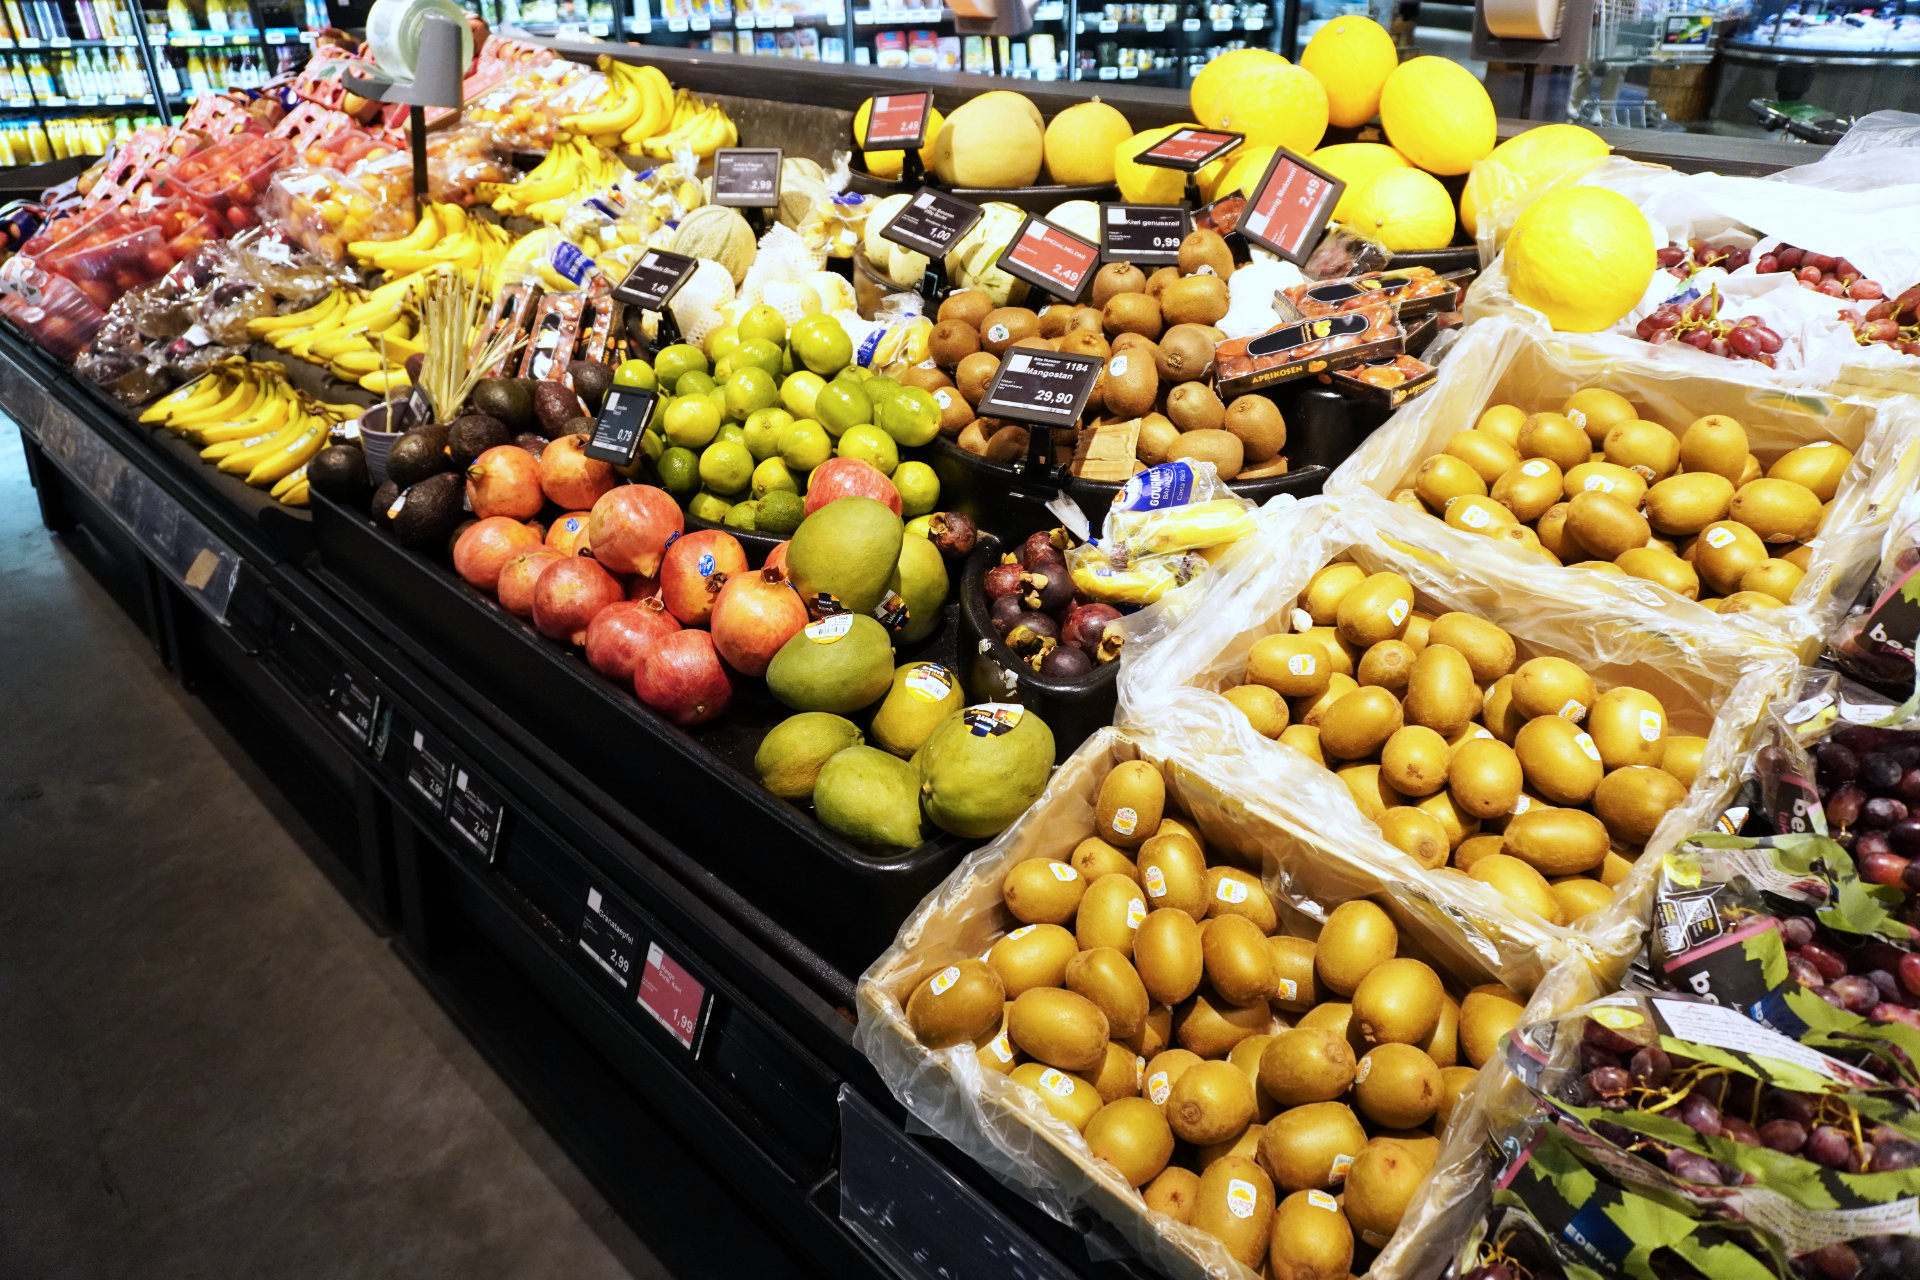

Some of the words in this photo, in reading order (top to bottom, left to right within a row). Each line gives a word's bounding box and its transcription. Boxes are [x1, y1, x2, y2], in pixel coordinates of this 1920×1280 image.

[900, 121, 919, 132] 2,49
[751, 180, 772, 190] 2,99
[1299, 178, 1320, 208] 2,49
[930, 228, 951, 241] 1,00
[1153, 237, 1180, 248] 0,99
[1043, 236, 1087, 260] SPEZIALMELONE
[1052, 264, 1078, 281] 2,49
[651, 282, 668, 294] 1,49
[1025, 367, 1073, 380] Mangostan
[1066, 362, 1088, 372] 1184
[1252, 365, 1303, 384] APRIKOSEN
[1034, 389, 1073, 404] 29,90
[617, 429, 633, 442] 0,79
[1177, 482, 1185, 501] Costa
[474, 821, 488, 841] 2,49
[599, 909, 634, 945] Granataepfel
[610, 949, 629, 973] 2,99
[673, 1008, 693, 1034] 1,99
[1564, 1222, 1617, 1273] EDEKA
